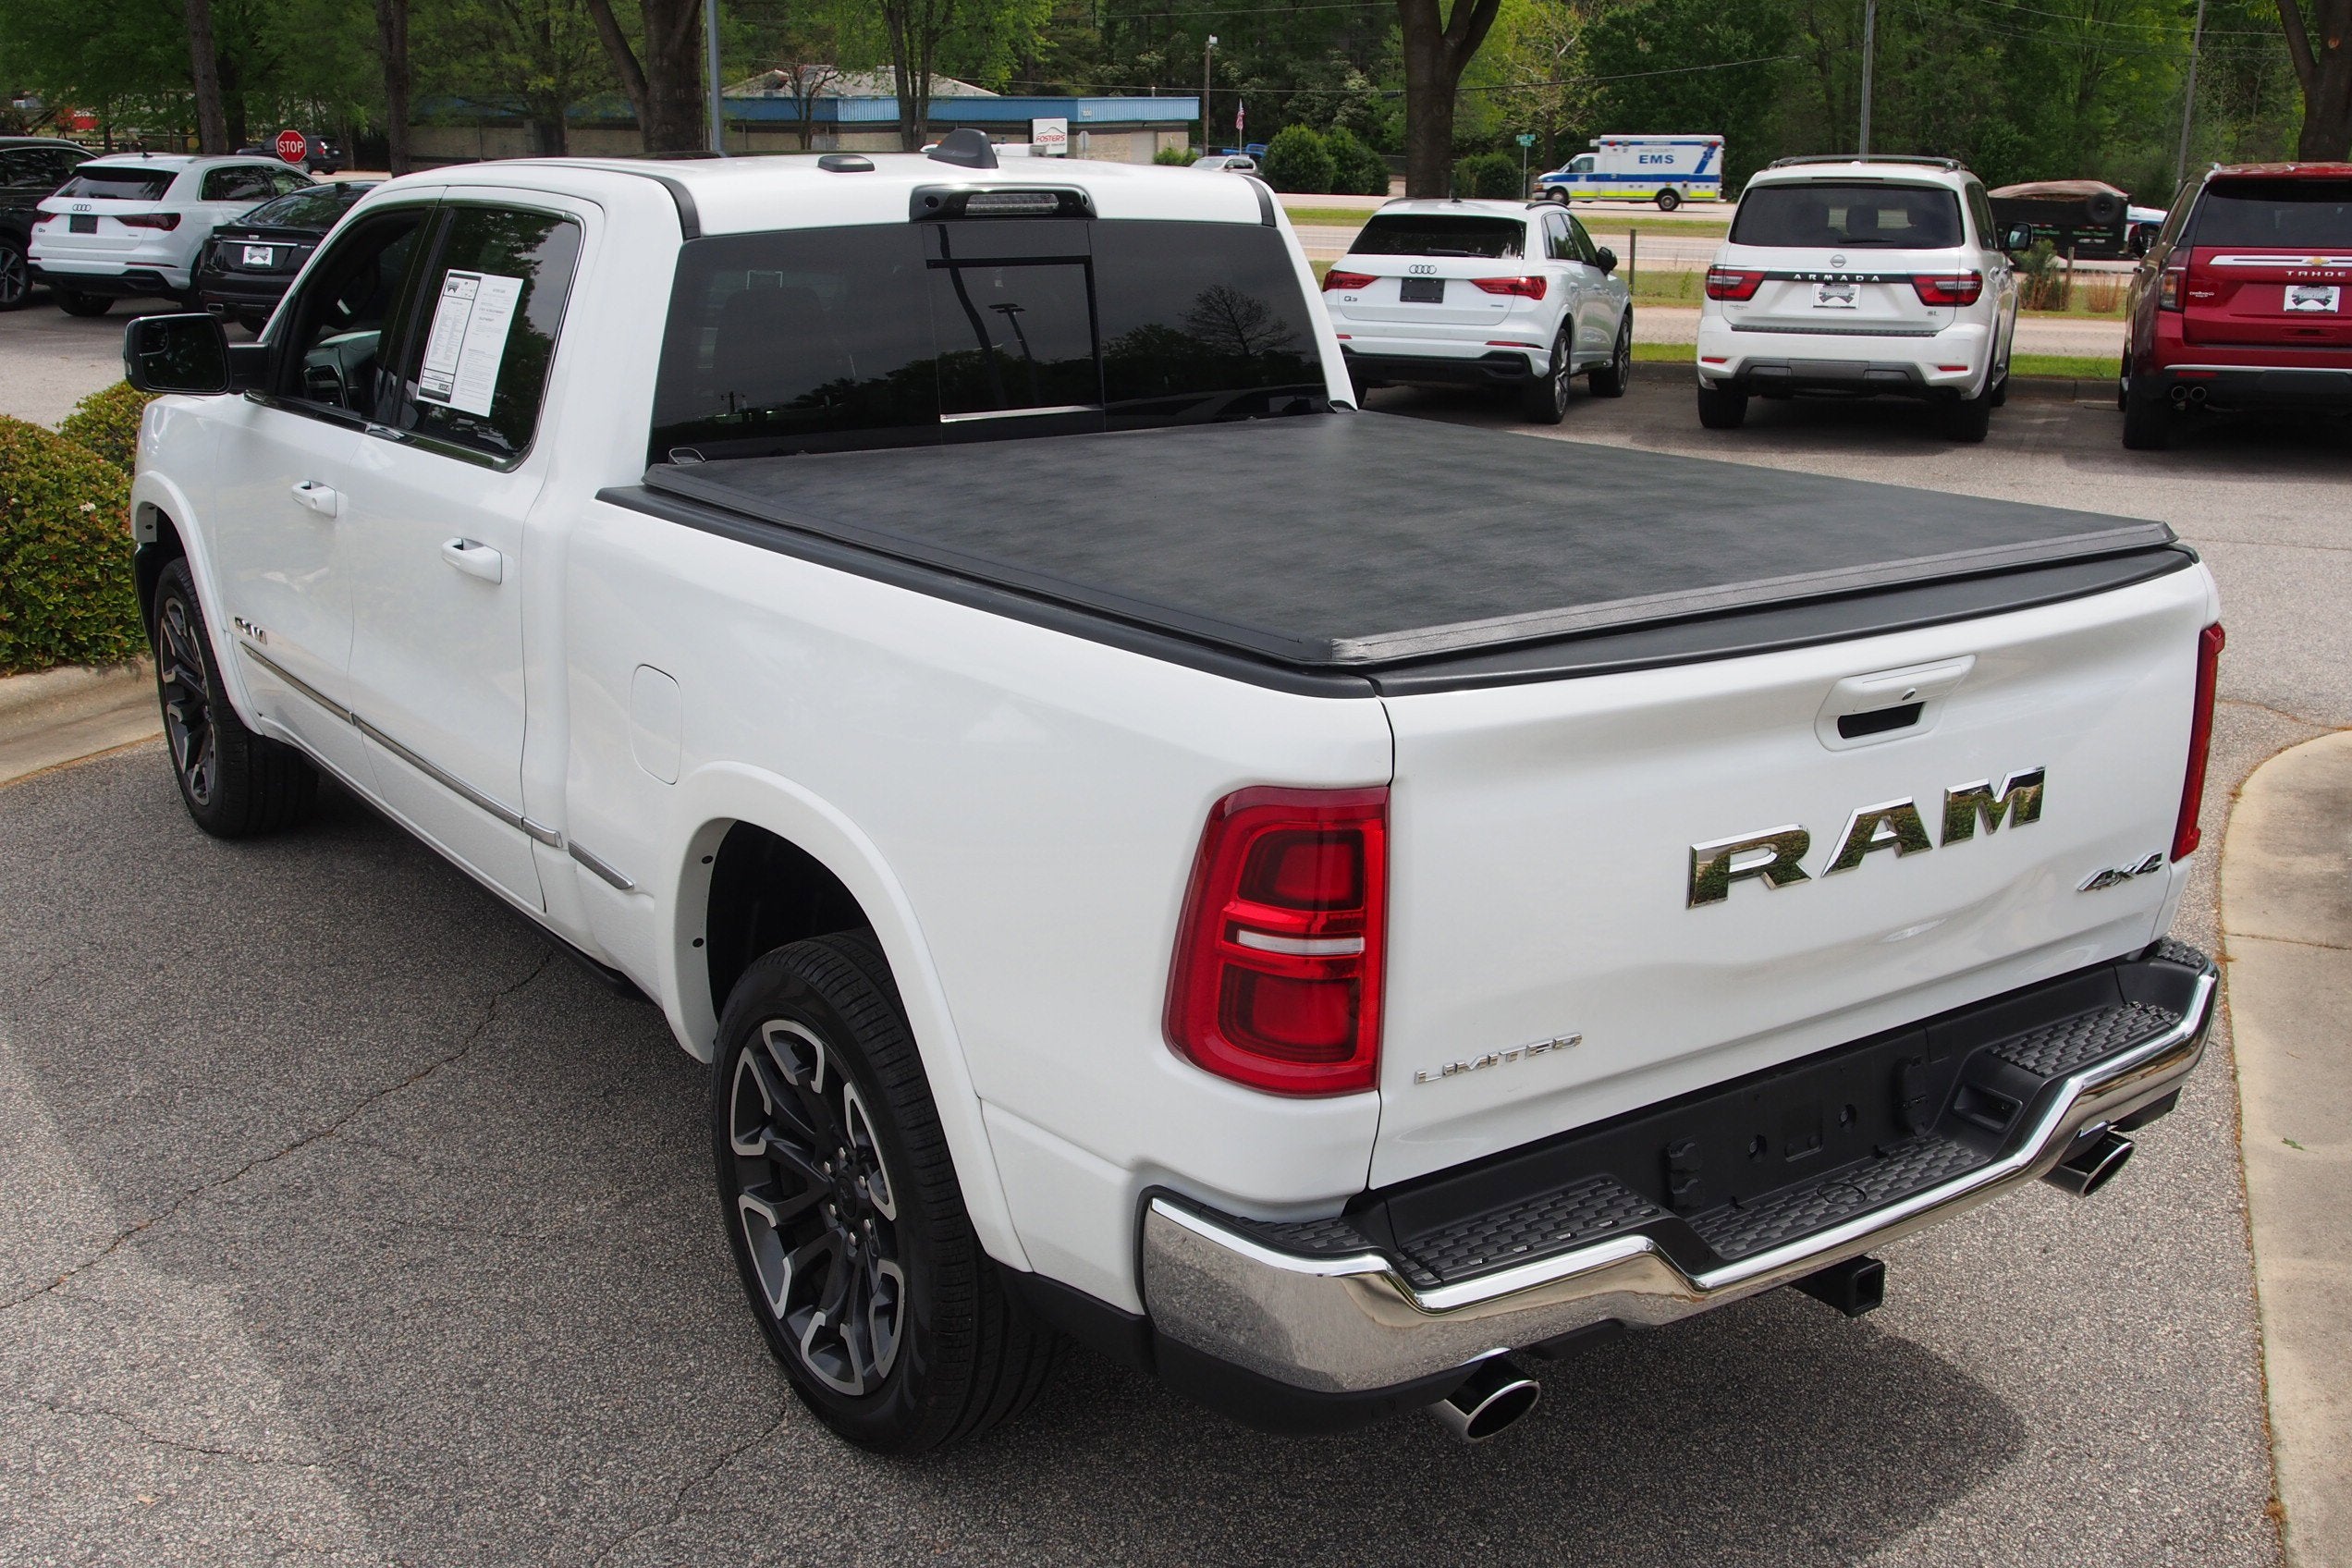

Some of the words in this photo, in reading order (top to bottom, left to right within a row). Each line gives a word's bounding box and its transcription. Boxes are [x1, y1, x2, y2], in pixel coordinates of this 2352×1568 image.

[279, 141, 304, 153] STOP
[1639, 154, 1674, 164] EMS
[1794, 274, 1880, 282] ARMADA
[1685, 764, 2046, 910] RAM
[1415, 1032, 1583, 1084] LIMITED
